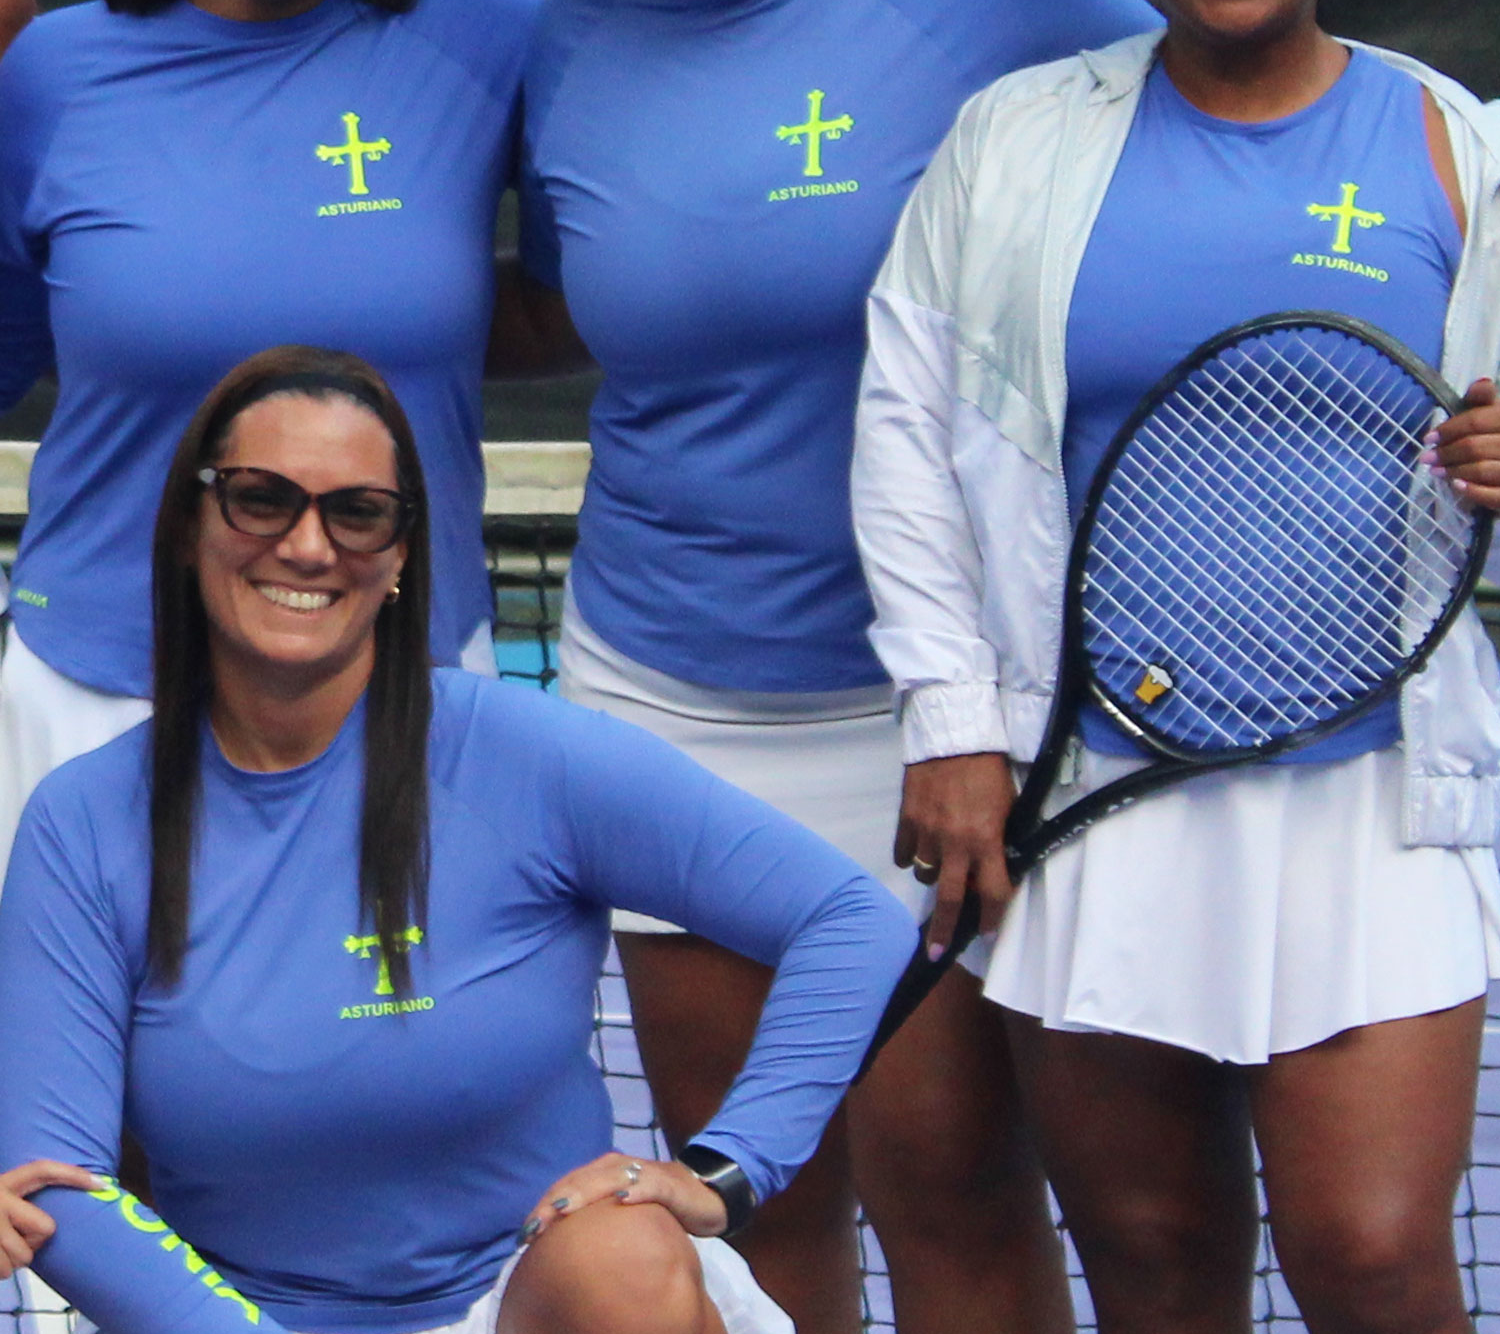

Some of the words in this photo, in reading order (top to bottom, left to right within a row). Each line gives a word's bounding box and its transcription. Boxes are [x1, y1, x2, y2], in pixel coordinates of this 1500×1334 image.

[768, 180, 860, 202] ASTURIANO
[317, 198, 404, 218] ASTURIANO
[1291, 252, 1390, 283] ASTURIANO
[340, 997, 436, 1020] ASTURIANO
